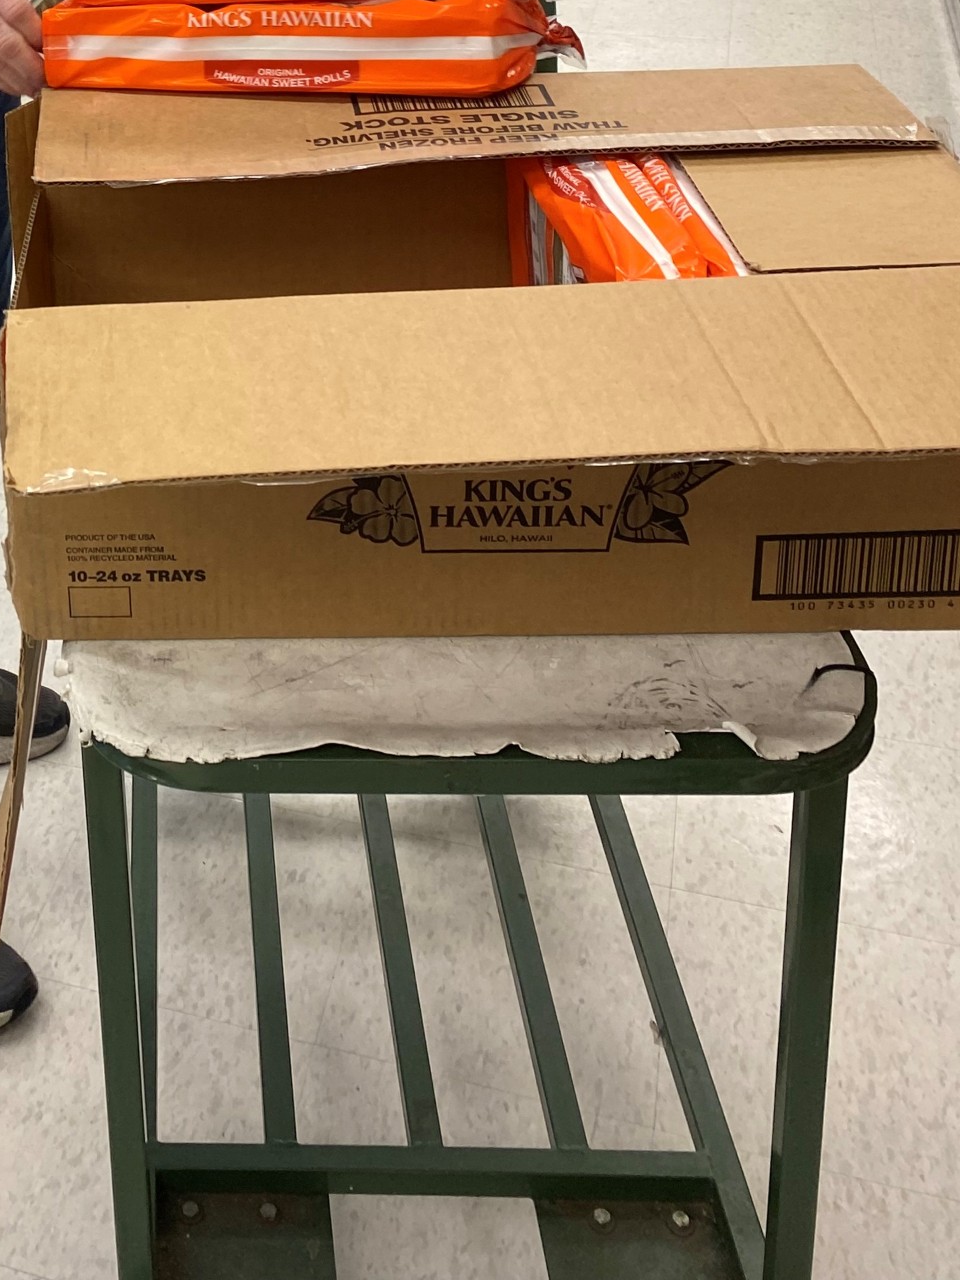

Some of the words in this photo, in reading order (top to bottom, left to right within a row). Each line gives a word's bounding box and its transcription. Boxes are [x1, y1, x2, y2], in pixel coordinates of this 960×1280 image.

[260, 10, 373, 28] HAWAIIAN
[257, 67, 305, 76] ORIGINAL
[213, 69, 270, 87] HAWAIIAN
[271, 77, 311, 88] SWEET
[314, 69, 352, 85] ROLLS
[460, 109, 580, 122] SINGLE
[340, 117, 452, 132] STOCK
[443, 123, 545, 136] BEFORE
[553, 120, 629, 131] THAW
[379, 136, 477, 151] FROZEN
[482, 133, 559, 145] KEEP
[463, 477, 572, 502] KING'S
[429, 505, 606, 528] HAWAIIAN
[479, 535, 509, 543] HILO,
[511, 534, 553, 542] HAWAII
[121, 573, 142, 582] oz
[146, 569, 207, 582] TRAYS
[791, 601, 816, 611] 100
[827, 600, 875, 610] 73435
[887, 599, 936, 609] 00230
[947, 600, 954, 608] 4
